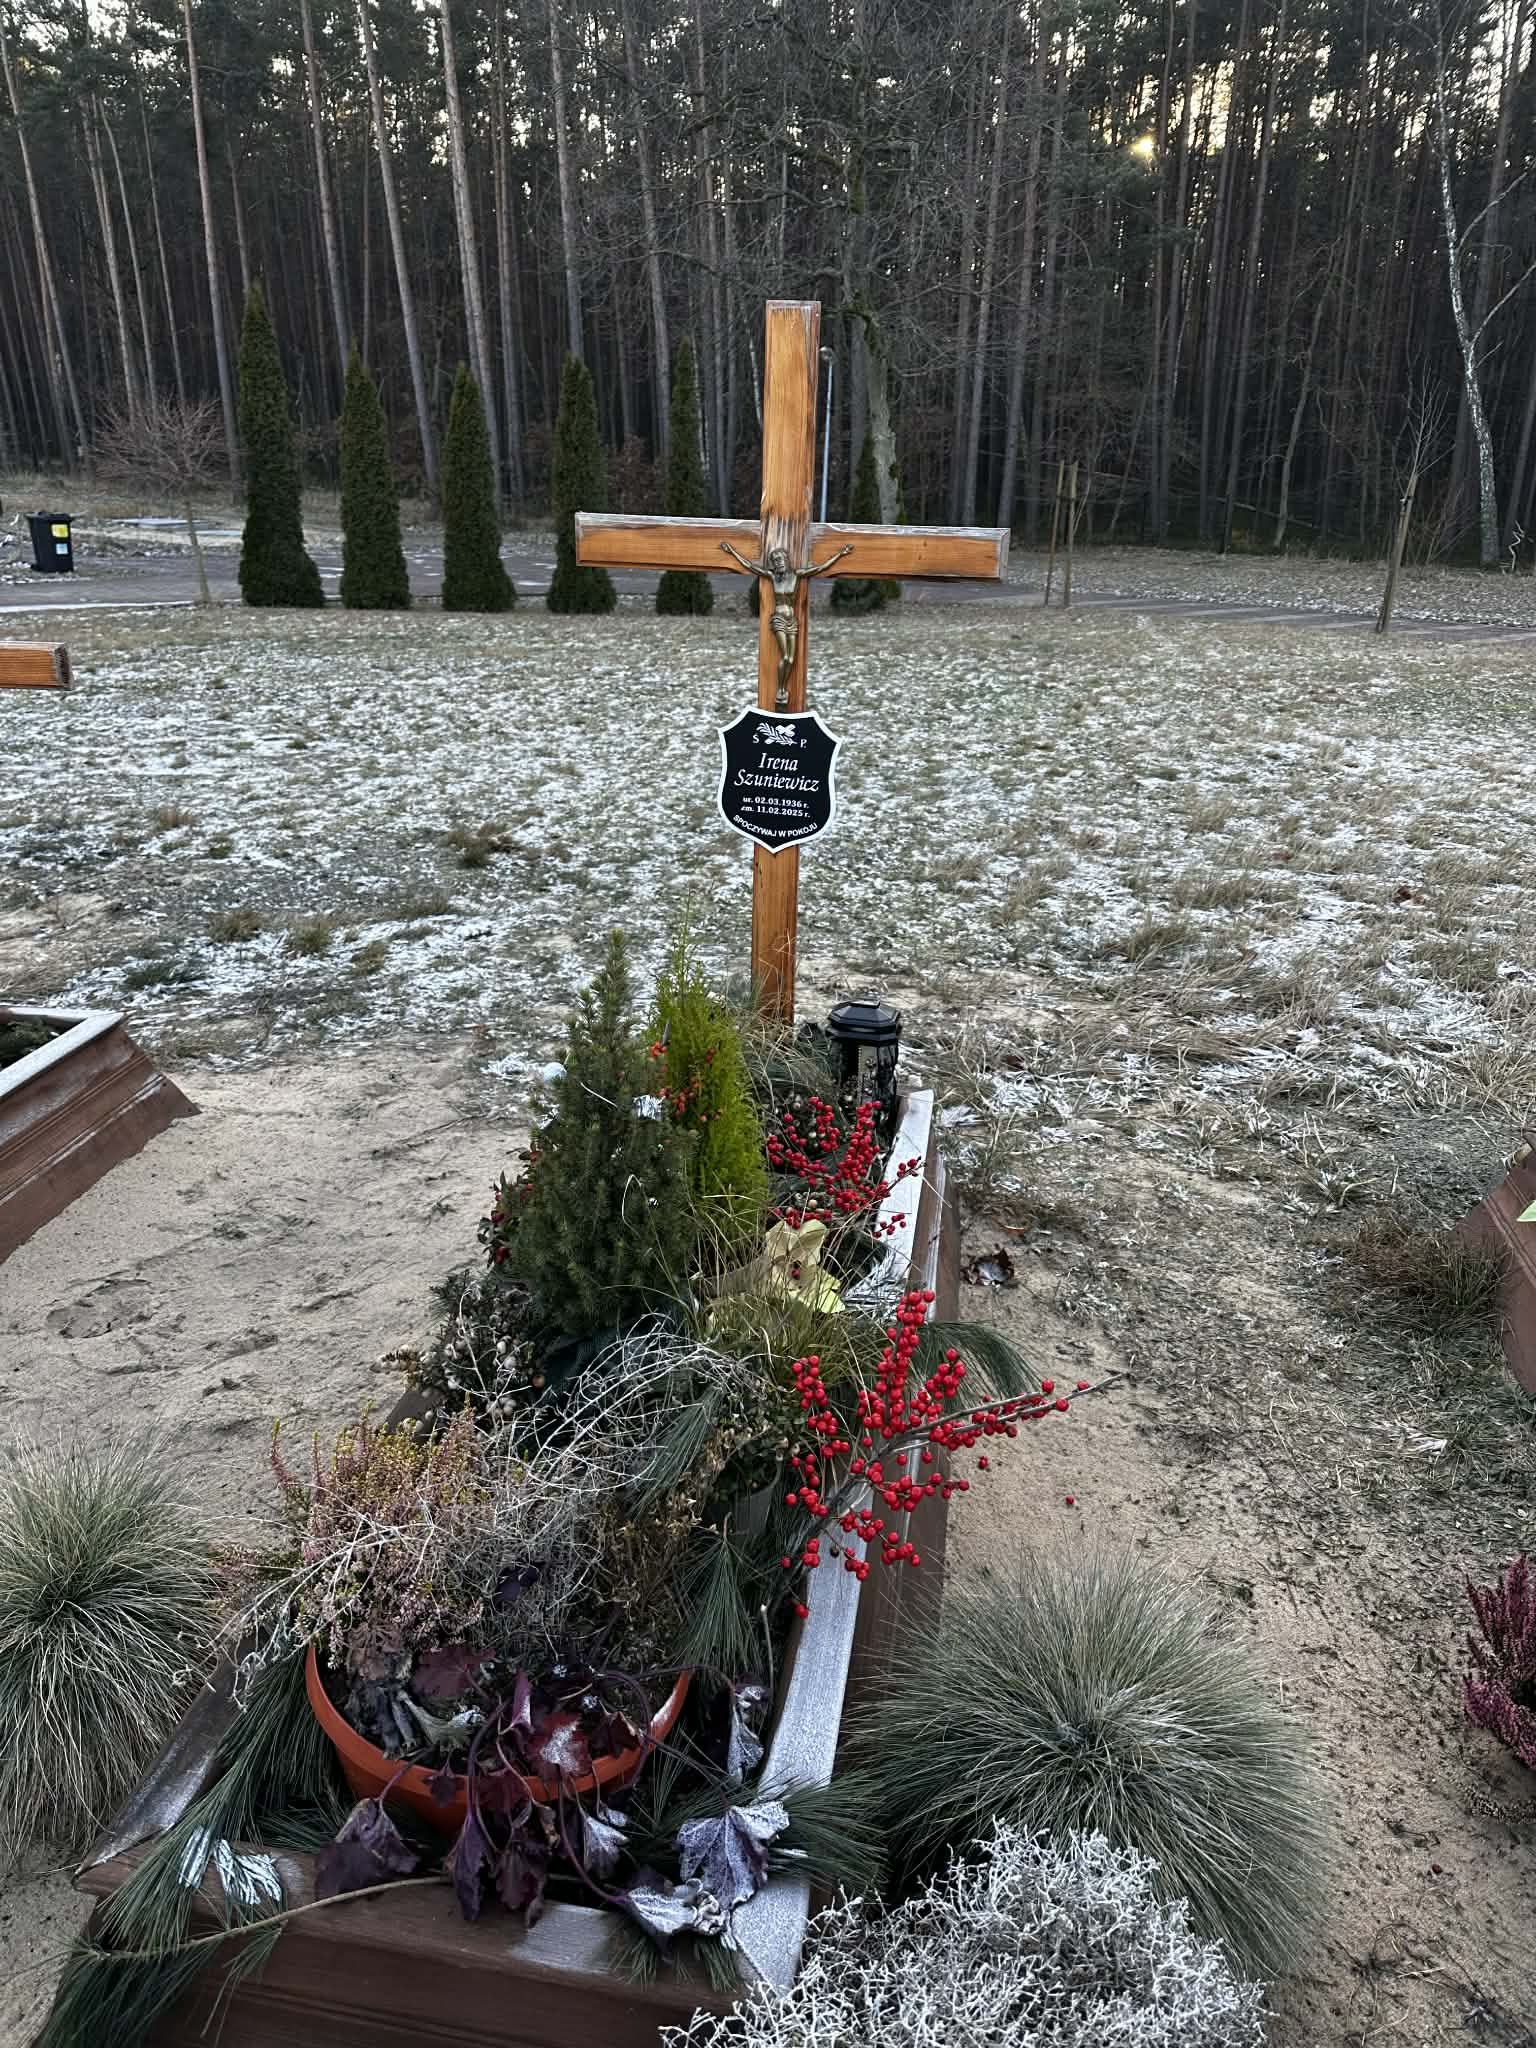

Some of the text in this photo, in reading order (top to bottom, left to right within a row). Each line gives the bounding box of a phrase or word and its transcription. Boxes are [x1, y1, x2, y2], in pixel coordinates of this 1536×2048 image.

[758, 752, 799, 771] Irena
[733, 768, 820, 792] Szuniewicz
[755, 796, 802, 807] 02.03.1936
[757, 806, 803, 817] 11.02.2025
[733, 814, 819, 838] SPOCZYWAJ W POKOJU
